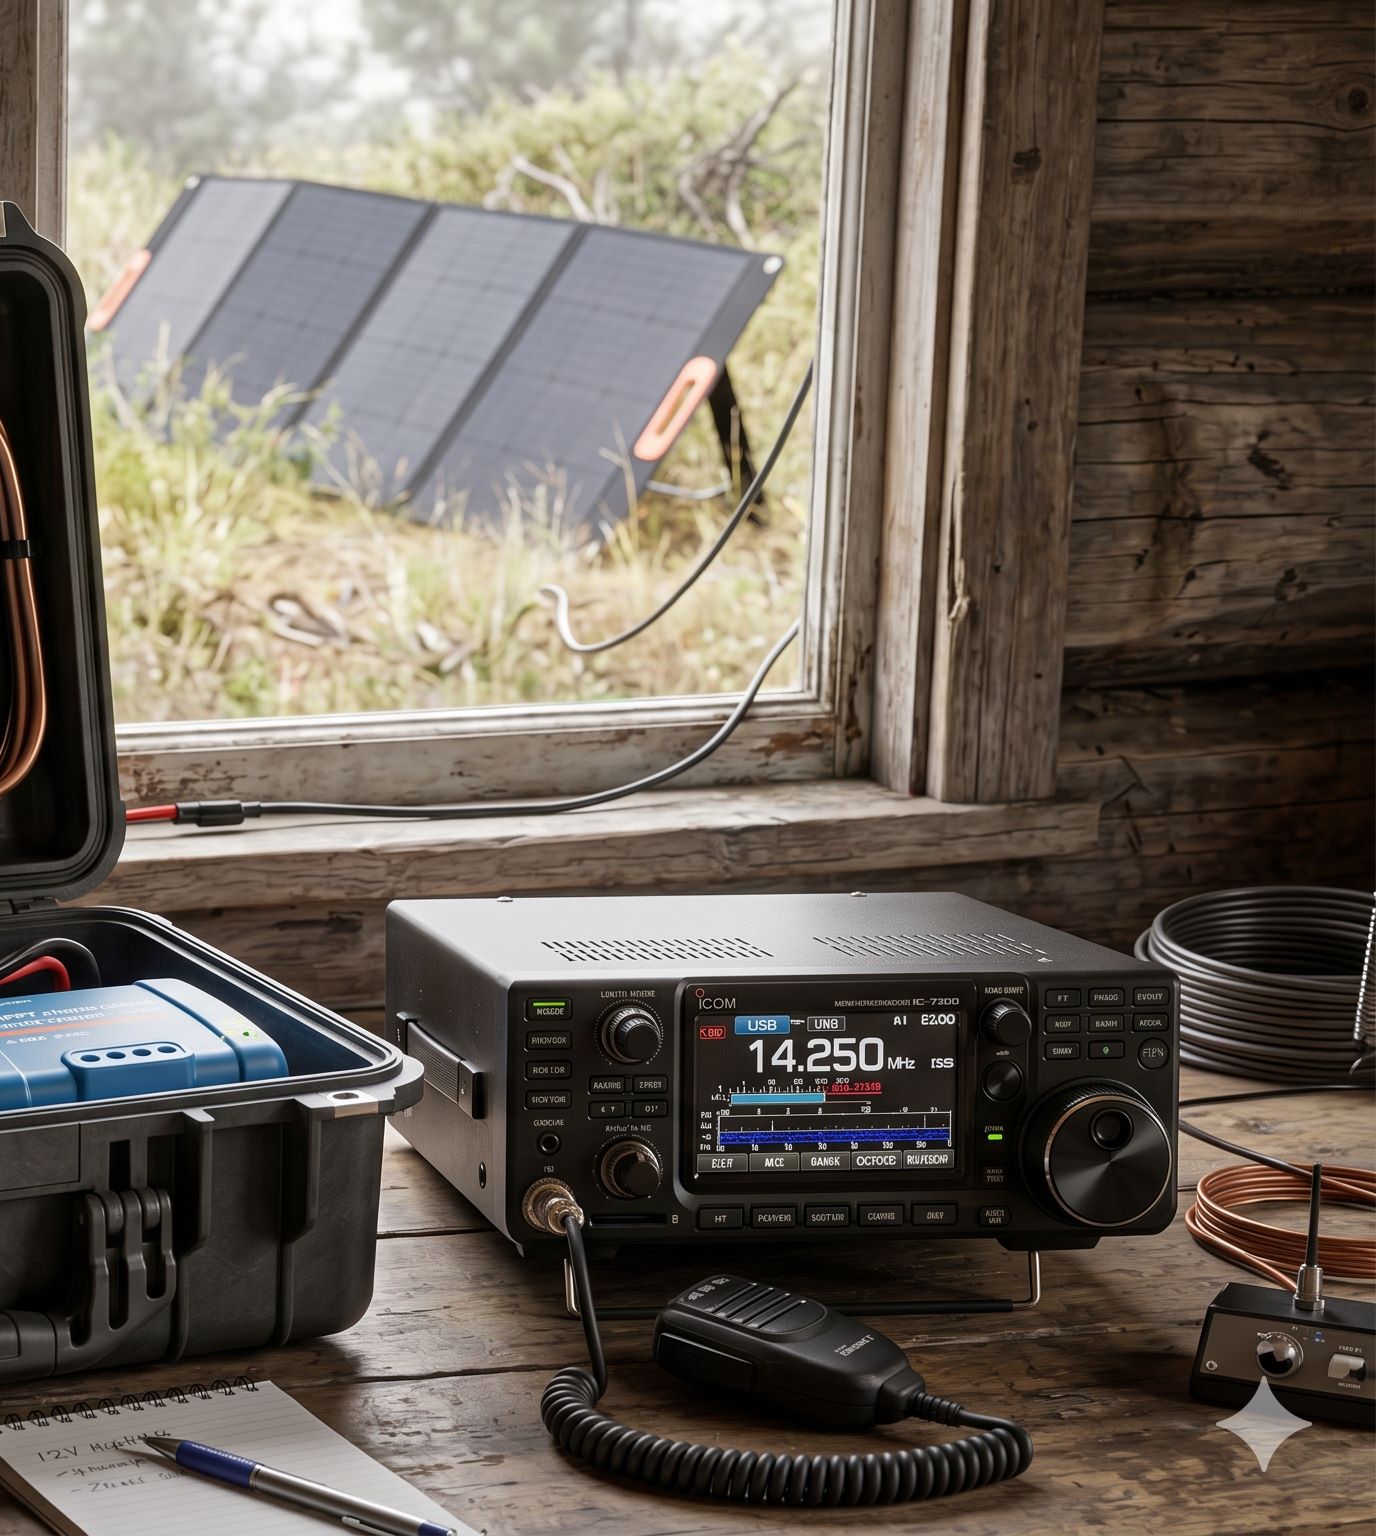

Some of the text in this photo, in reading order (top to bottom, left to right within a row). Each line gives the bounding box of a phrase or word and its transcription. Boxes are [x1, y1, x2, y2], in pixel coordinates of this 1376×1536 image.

[747, 1019, 777, 1031] USB
[749, 1037, 884, 1073] 14.250
[887, 1056, 916, 1069] MHz
[37, 1446, 78, 1462] 12V
